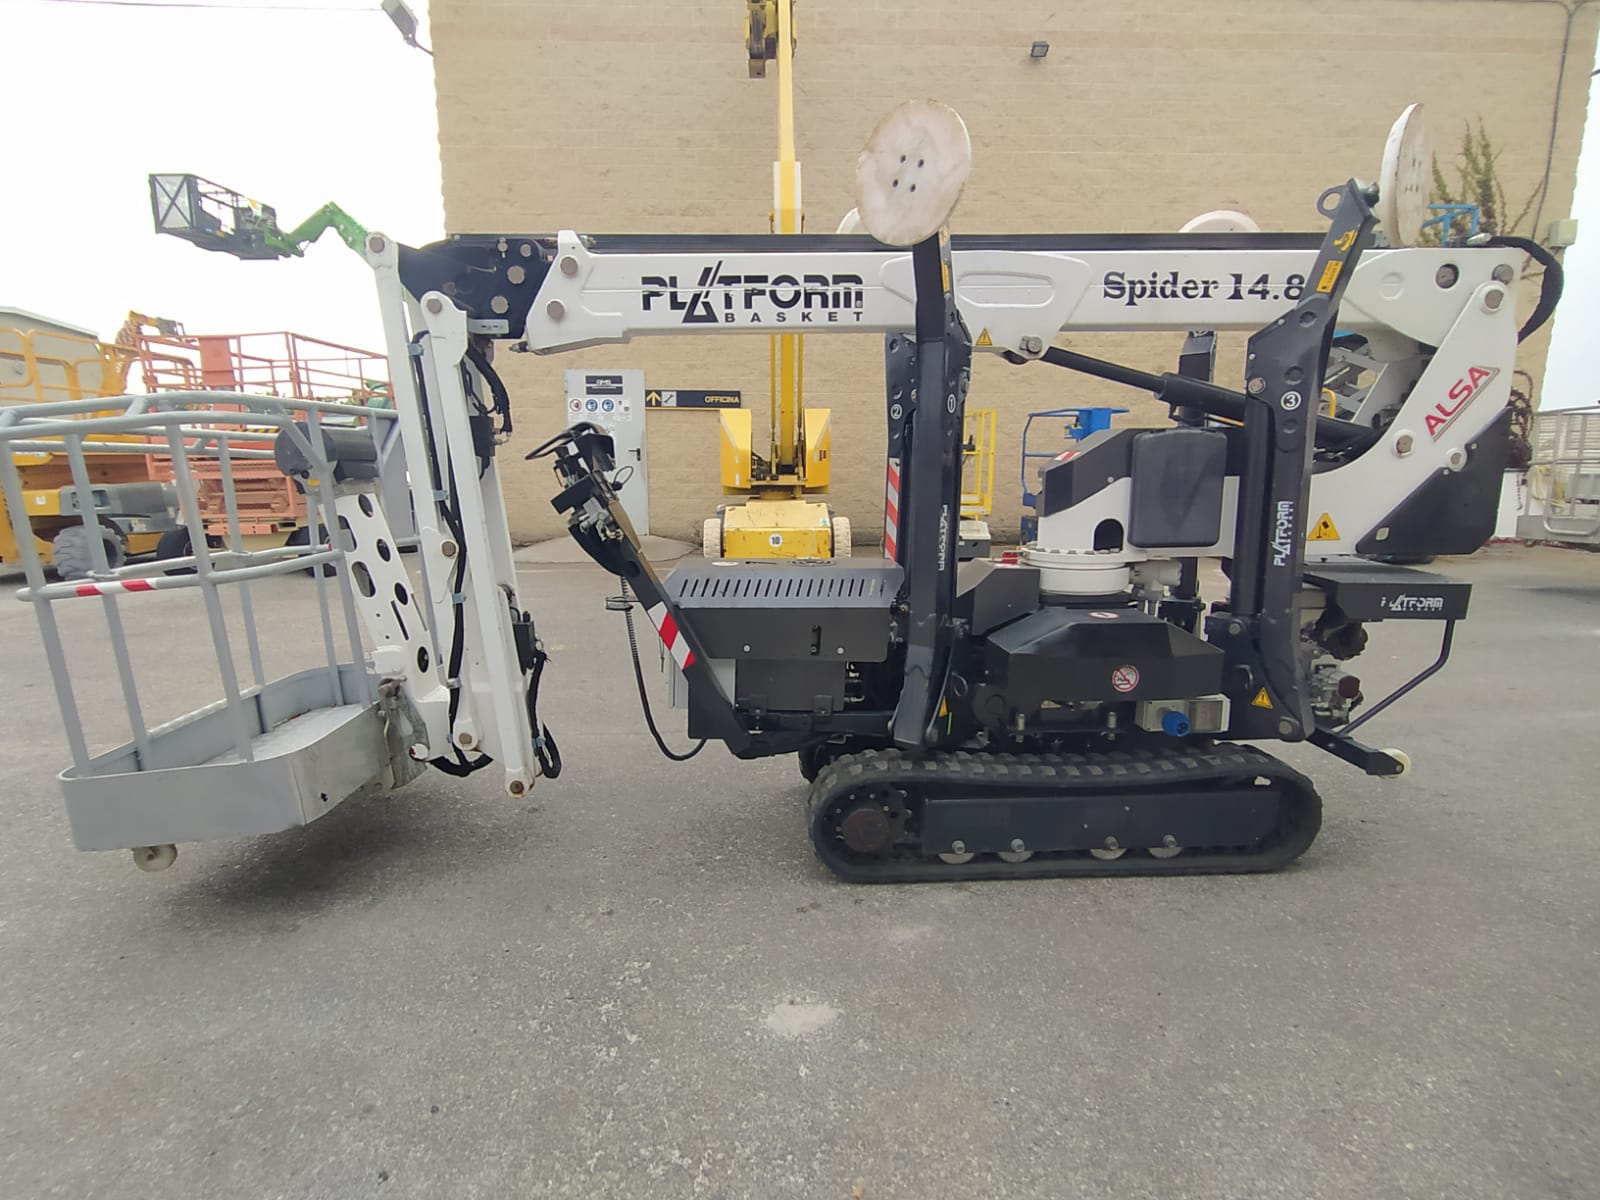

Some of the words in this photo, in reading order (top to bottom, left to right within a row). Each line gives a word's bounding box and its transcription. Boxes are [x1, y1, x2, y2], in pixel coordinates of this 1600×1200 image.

[641, 260, 863, 323] PLATFORM
[1103, 271, 1219, 306] Spider
[1226, 272, 1306, 300] 14.8
[724, 312, 863, 323] BASKET
[1425, 367, 1491, 436] ALSA
